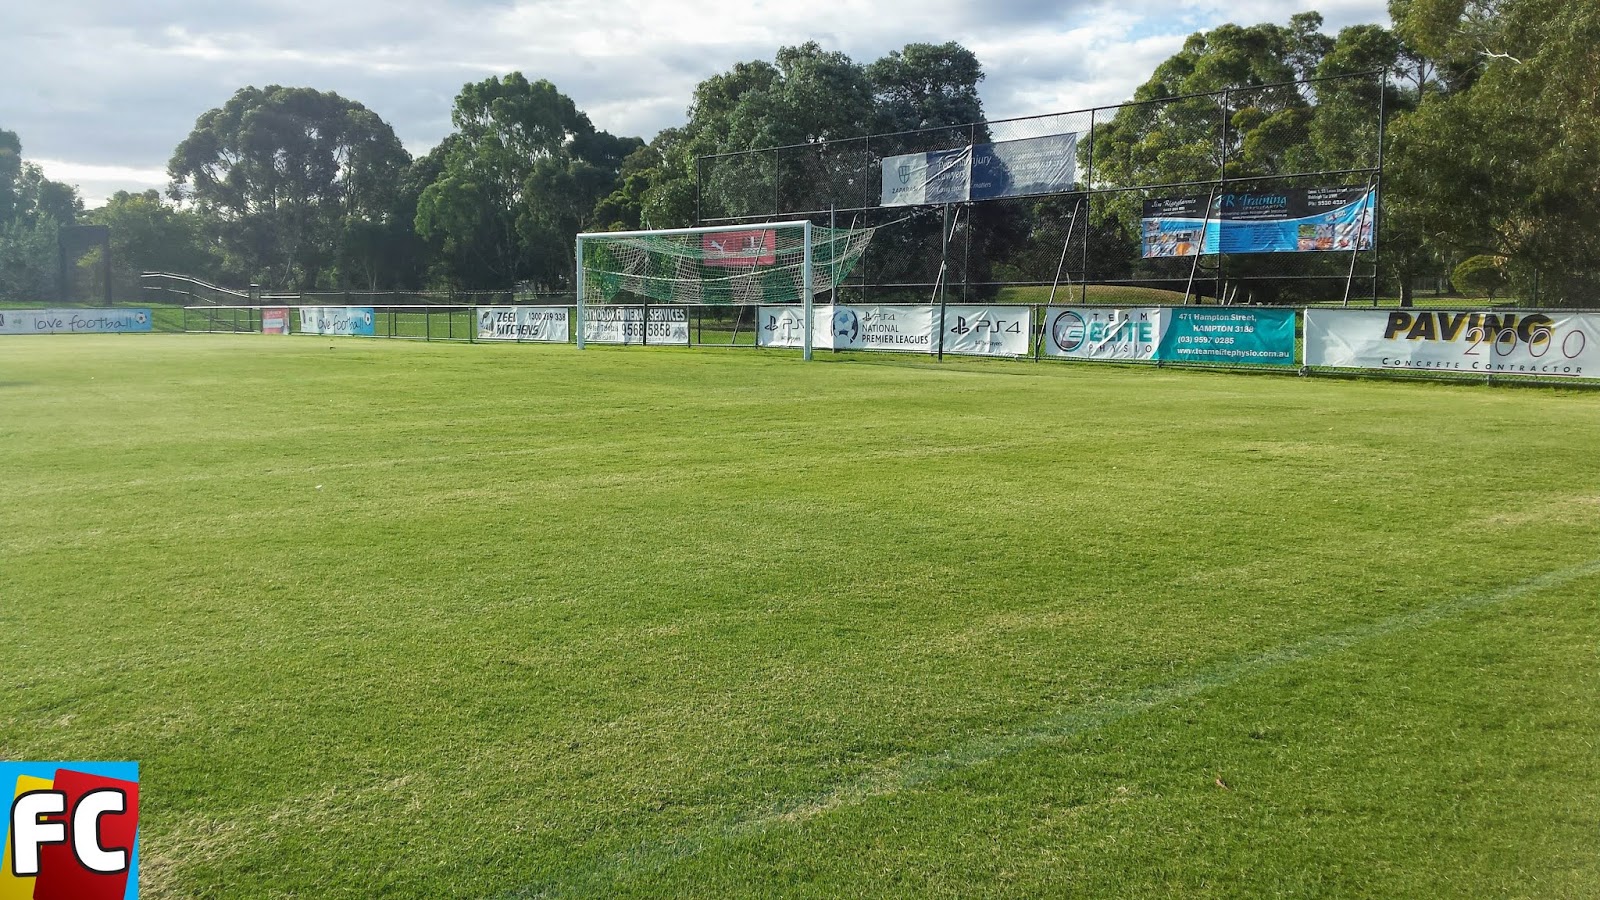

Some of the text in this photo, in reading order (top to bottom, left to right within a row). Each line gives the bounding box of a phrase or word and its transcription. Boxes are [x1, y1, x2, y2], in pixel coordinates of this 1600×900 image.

[971, 154, 992, 168] njury
[1240, 193, 1288, 208] Training
[583, 308, 686, 321] RTHODOX FUNERA SERVICES
[1093, 312, 1148, 322] TEAM
[1193, 313, 1230, 322] Hampton
[34, 314, 132, 331] love football
[317, 314, 364, 331] love football
[861, 324, 900, 333] NATIONAL
[976, 319, 1021, 334] PS4
[1192, 324, 1254, 333] HAMPTON 3188
[1384, 311, 1555, 346] PAVING
[496, 324, 539, 336] KITCHENS
[621, 323, 644, 337] 9568
[647, 323, 671, 337] 5858
[1089, 322, 1153, 343] ELITE
[861, 334, 929, 345] PREMIER LEAGUES
[1177, 335, 1235, 345] (03) 9597 0285
[1463, 326, 1587, 359] 2000
[1088, 344, 1153, 353] PHYSIO
[1381, 357, 1583, 374] CONCRETE CONTRACTOR
